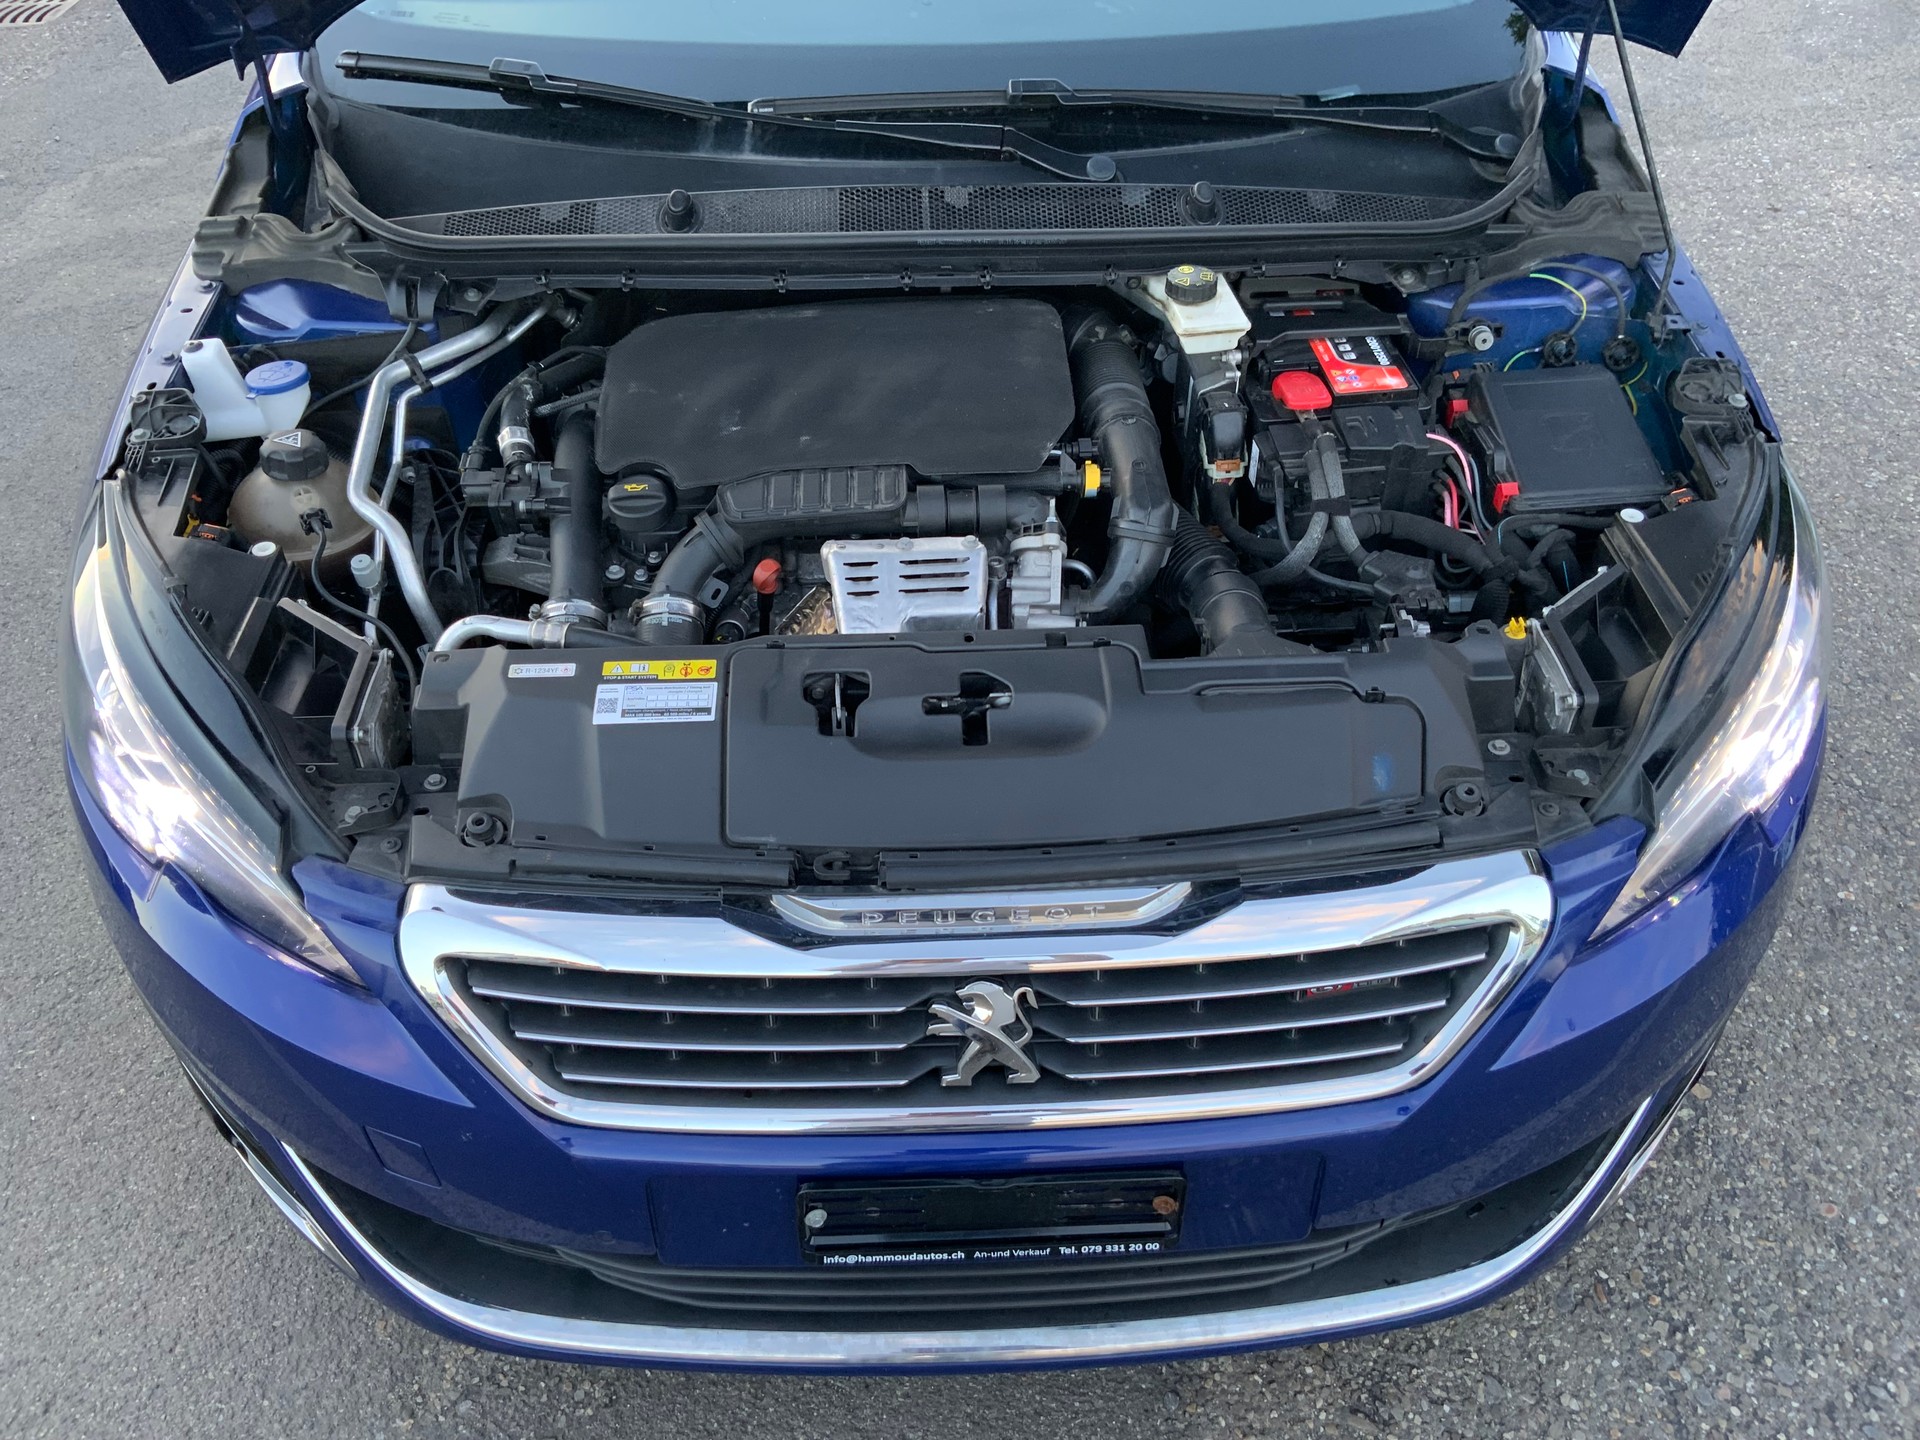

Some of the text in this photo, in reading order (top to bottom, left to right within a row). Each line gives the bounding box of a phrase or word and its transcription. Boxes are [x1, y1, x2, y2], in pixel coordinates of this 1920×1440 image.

[861, 904, 1106, 925] PEUGEOT
[974, 1250, 1010, 1258] An-und
[1012, 1248, 1051, 1257] Verkauf
[1058, 1246, 1078, 1255] Tel.
[1081, 1245, 1102, 1254] 079
[1105, 1244, 1125, 1253] 331
[1128, 1243, 1143, 1252] 20
[1145, 1242, 1160, 1251] 00
